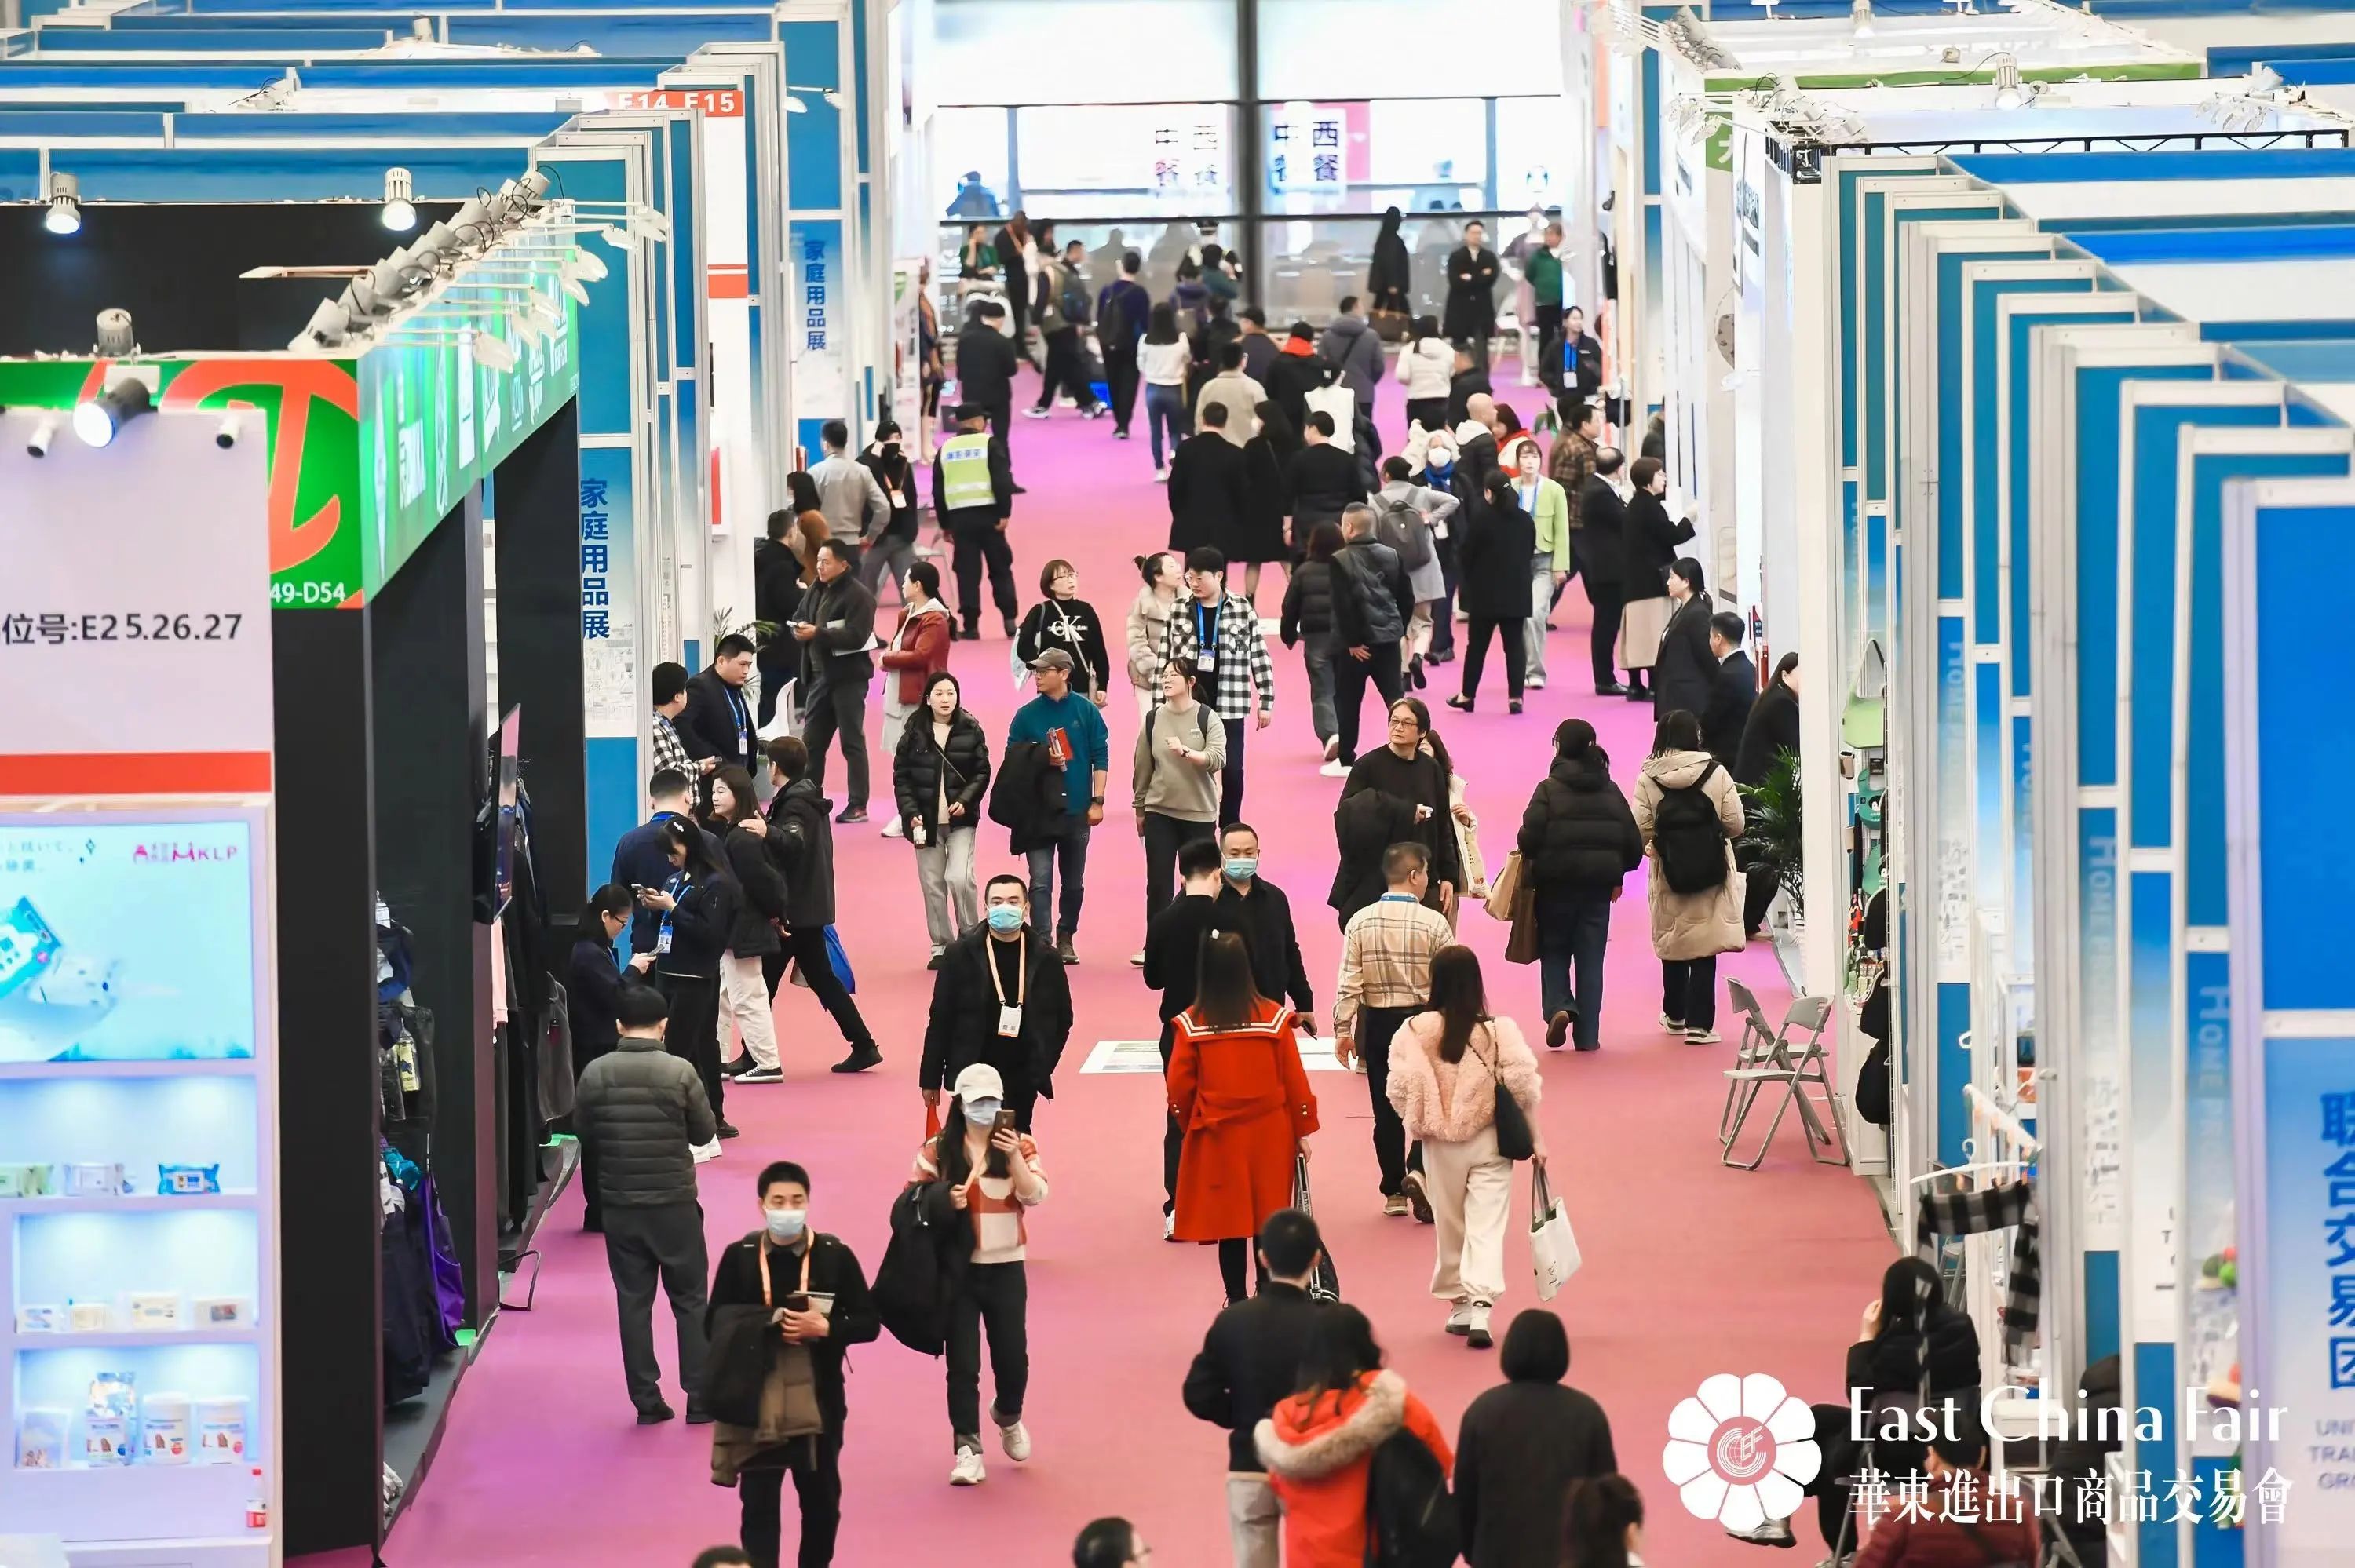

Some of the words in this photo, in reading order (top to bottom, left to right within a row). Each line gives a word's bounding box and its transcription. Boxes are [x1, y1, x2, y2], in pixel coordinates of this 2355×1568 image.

[804, 240, 826, 350] 家庭用品展
[580, 478, 610, 640] 家庭用品展
[2309, 1446, 2355, 1462] TRA
